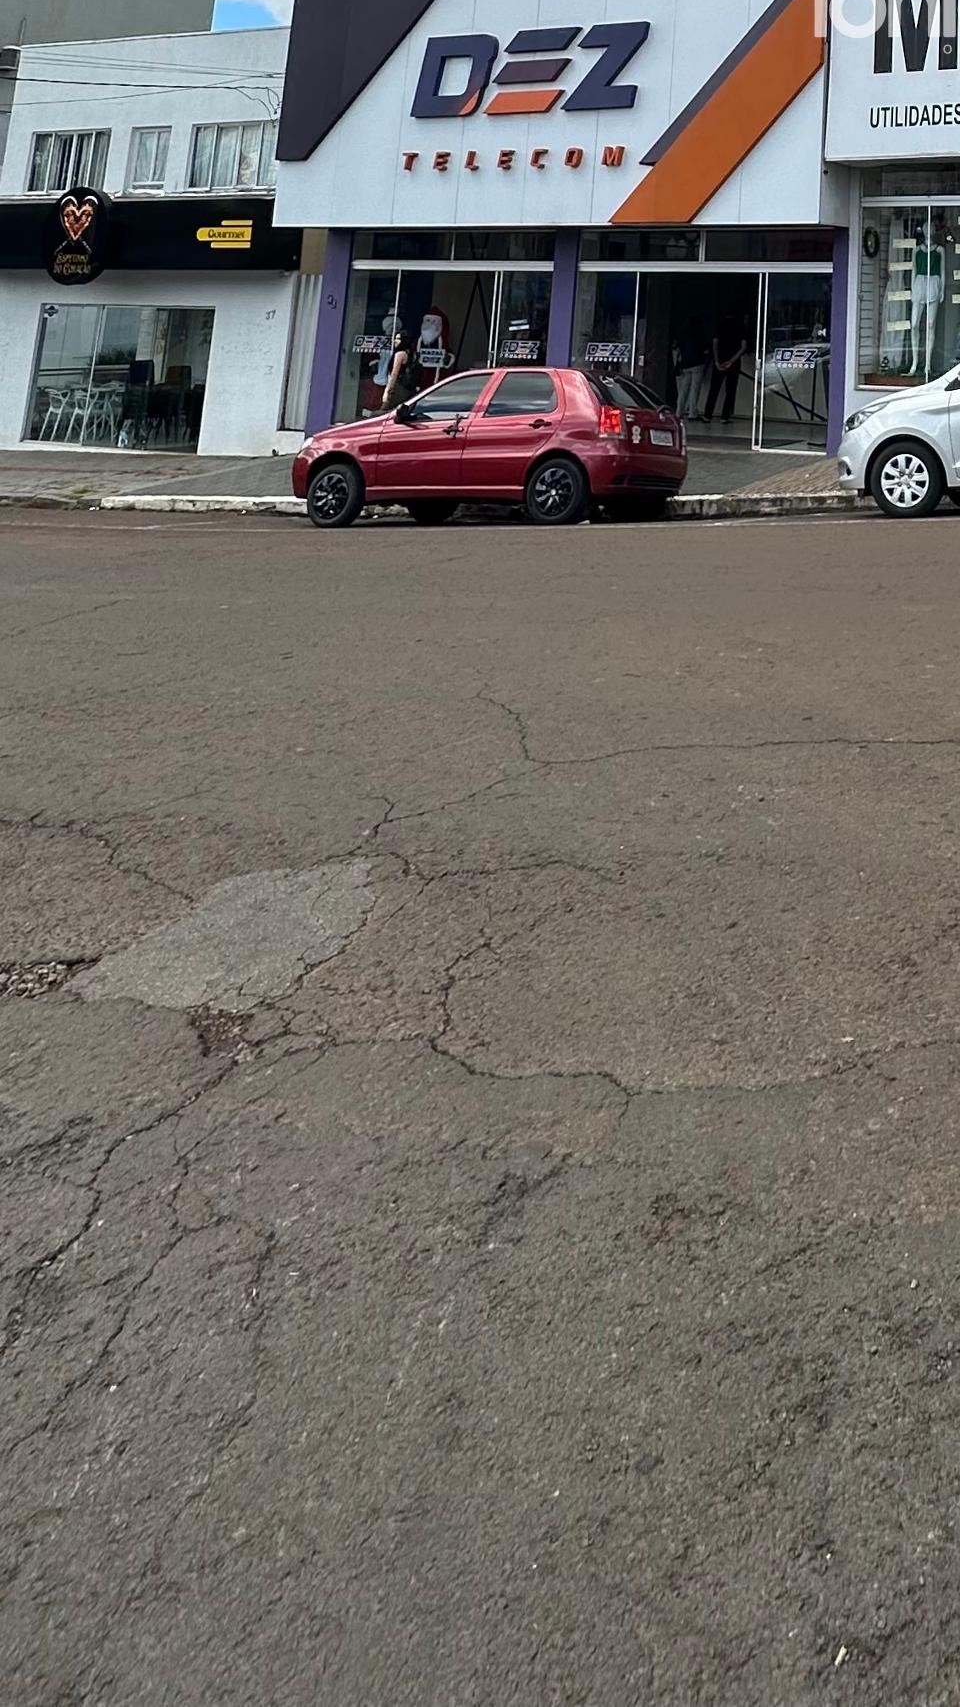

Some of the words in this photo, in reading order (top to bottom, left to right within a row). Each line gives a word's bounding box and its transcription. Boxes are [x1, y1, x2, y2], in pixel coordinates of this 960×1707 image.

[410, 21, 651, 119] DEZ
[402, 144, 627, 172] TELECOM
[208, 229, 246, 239] Gourmet
